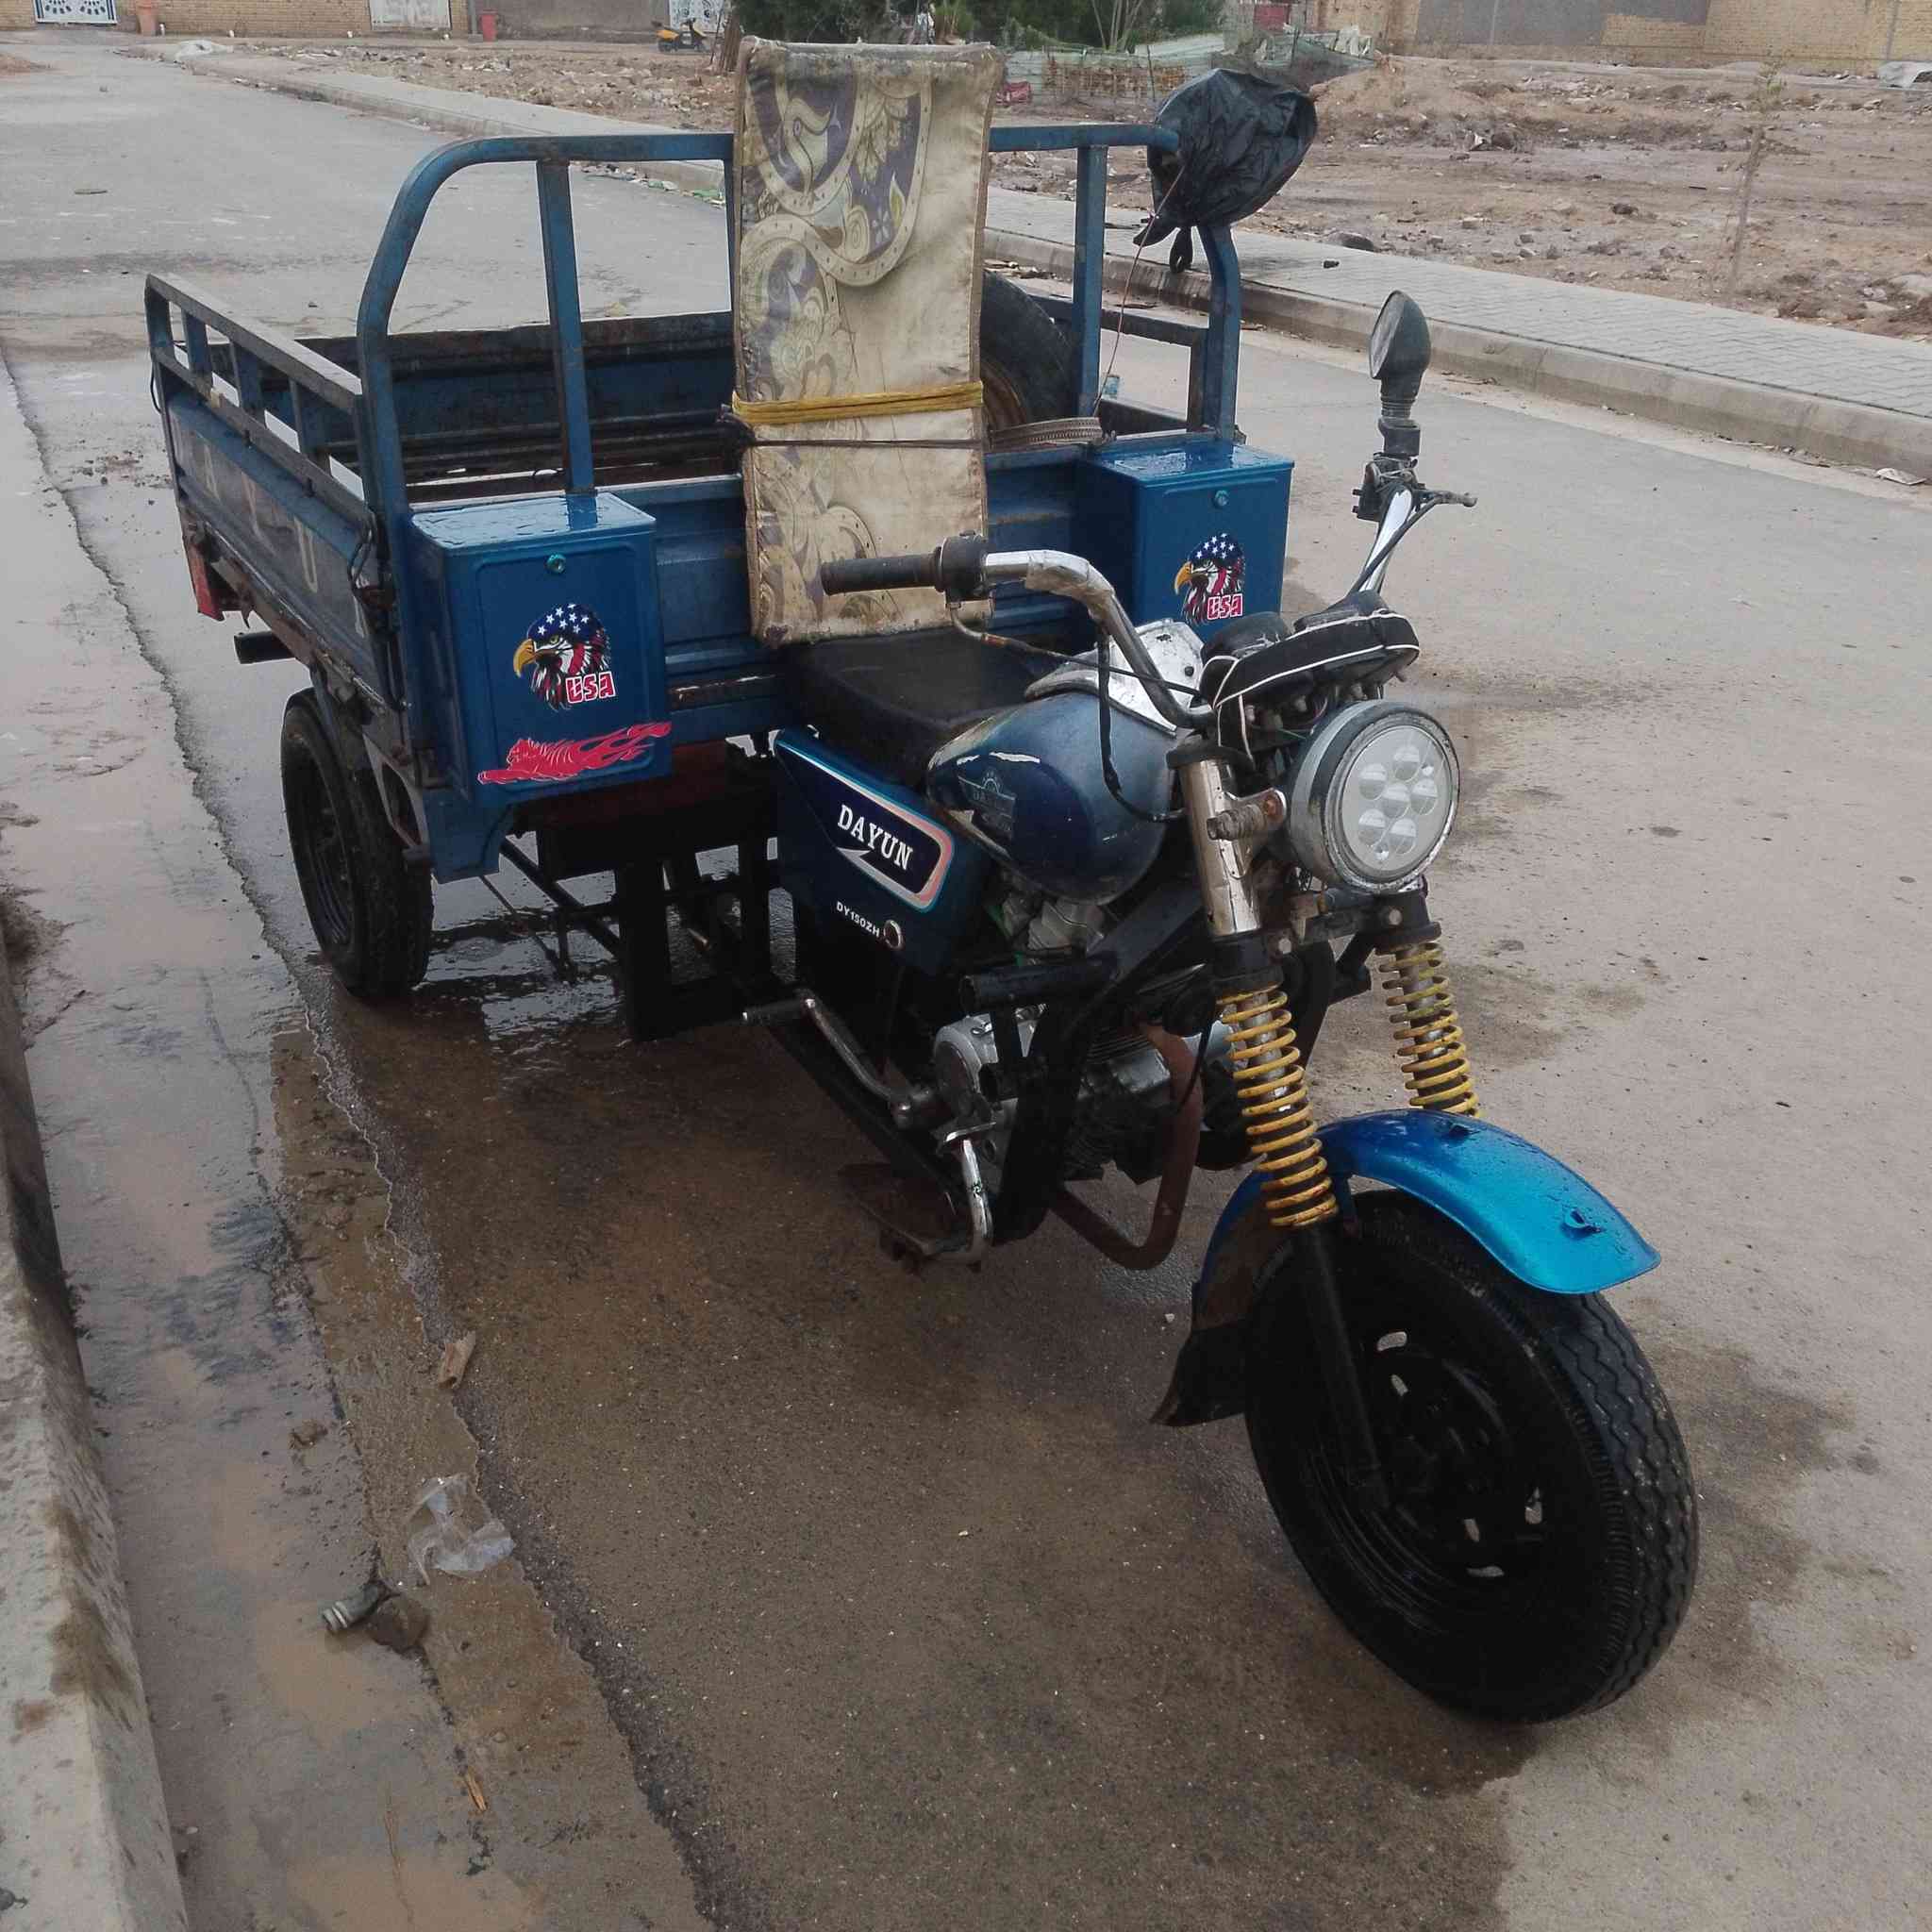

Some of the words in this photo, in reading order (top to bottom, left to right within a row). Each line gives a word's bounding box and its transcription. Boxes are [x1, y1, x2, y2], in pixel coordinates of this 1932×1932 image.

[1208, 593, 1243, 620] USA
[566, 671, 616, 704] USA
[837, 804, 913, 871] DAYUN
[836, 901, 880, 938] DY150ZH
